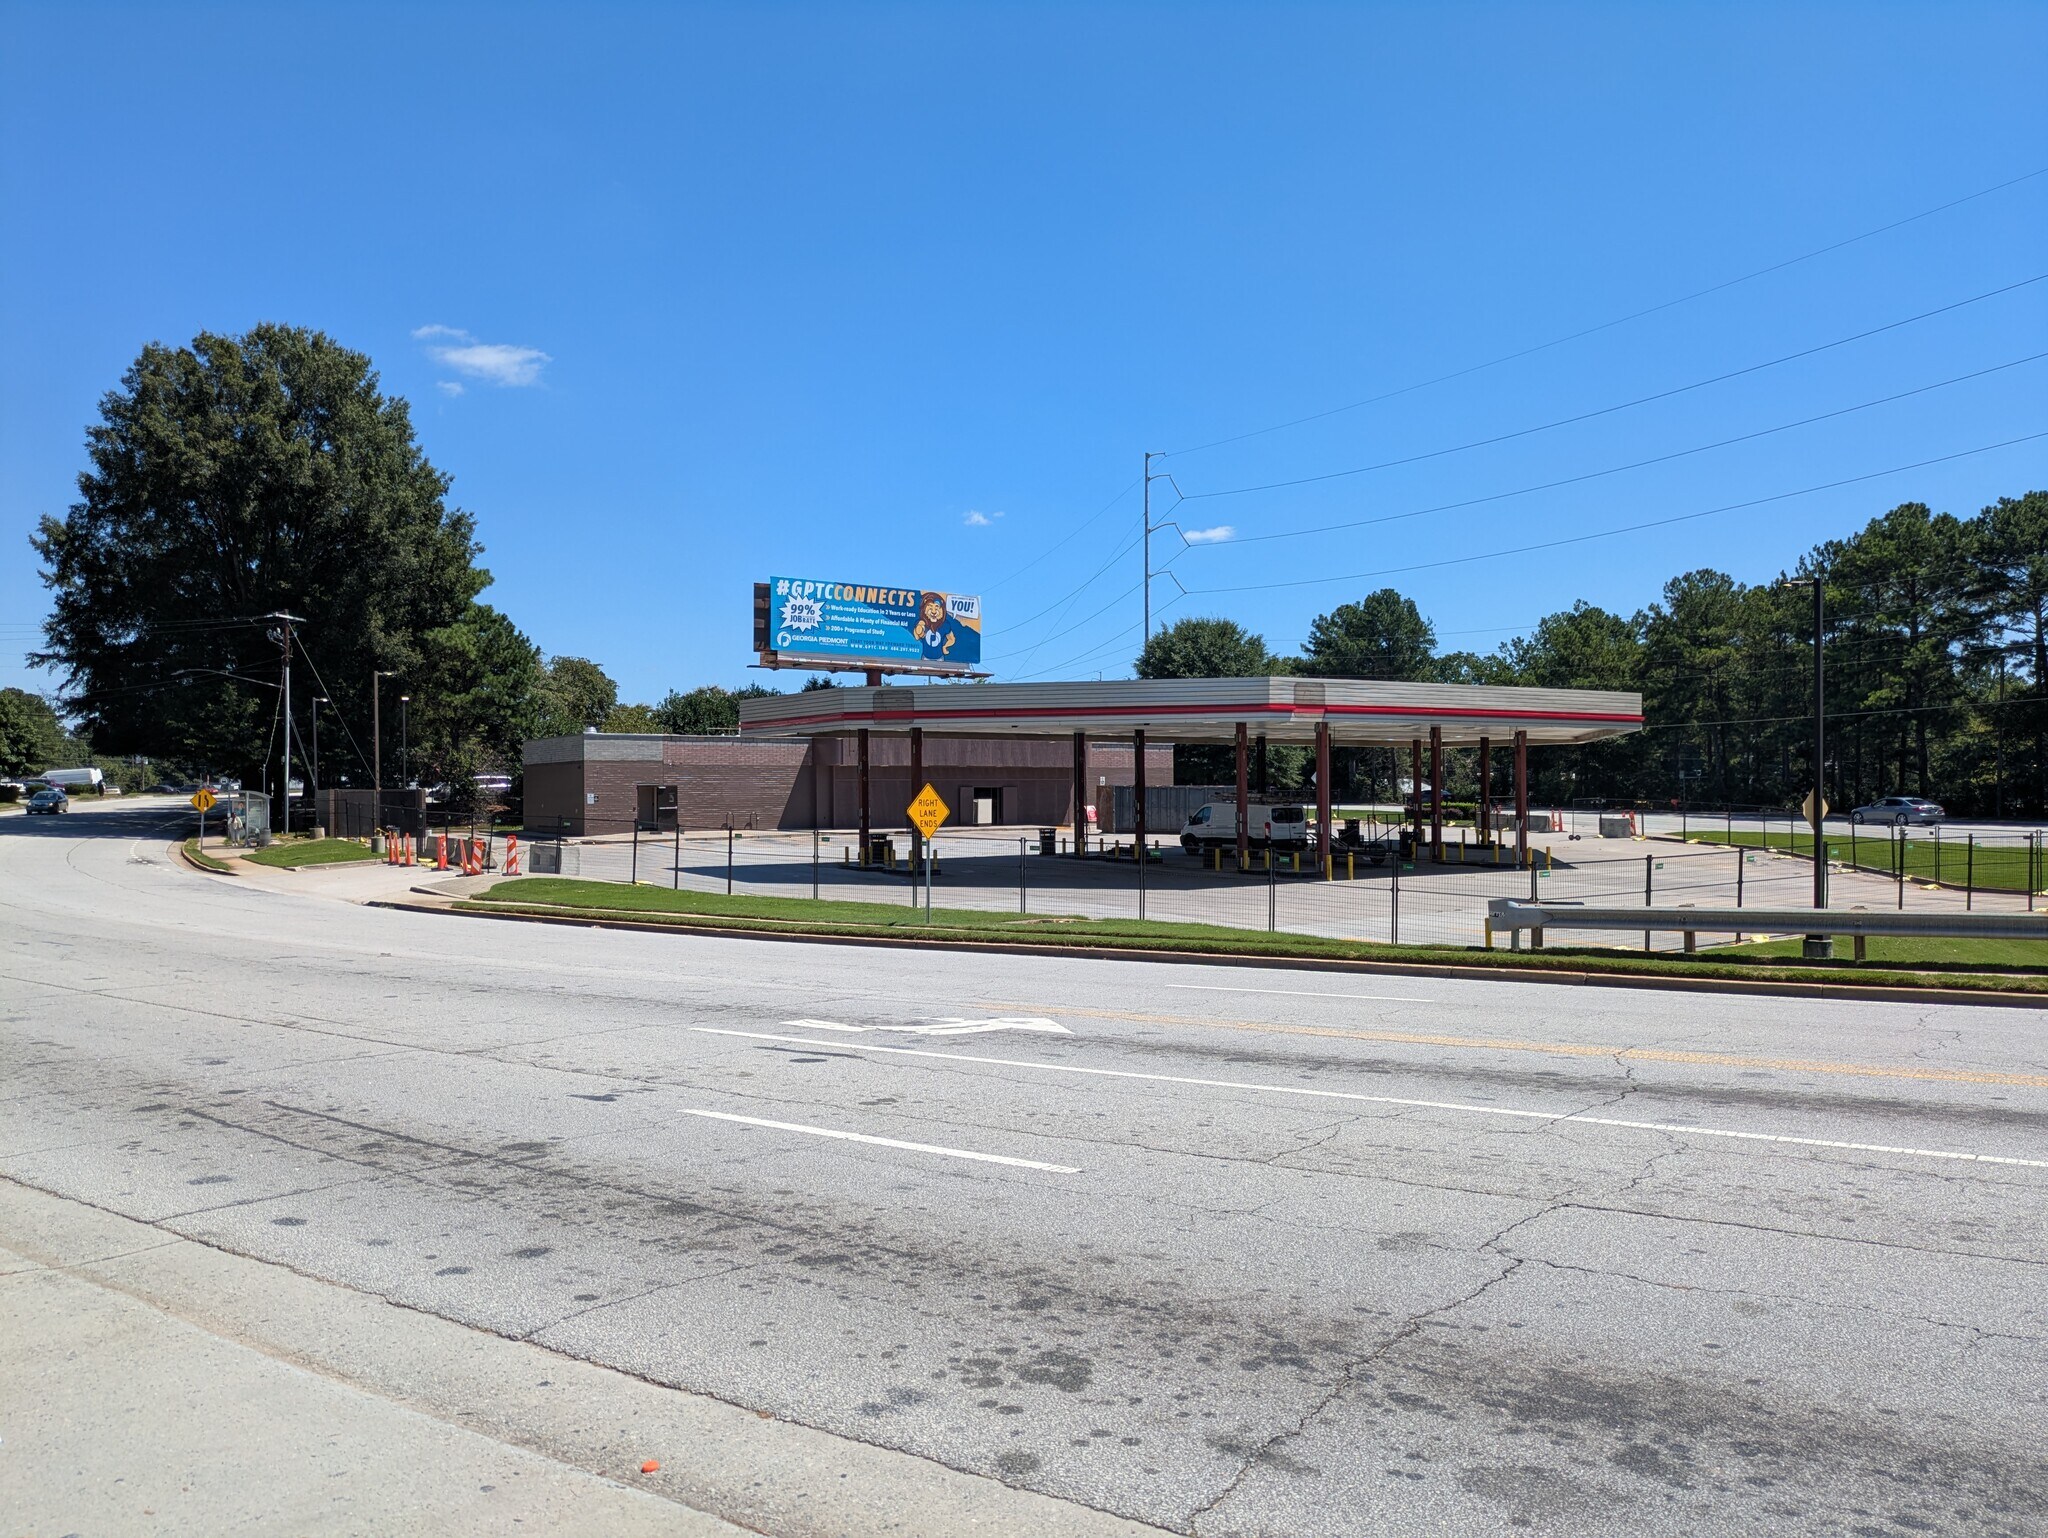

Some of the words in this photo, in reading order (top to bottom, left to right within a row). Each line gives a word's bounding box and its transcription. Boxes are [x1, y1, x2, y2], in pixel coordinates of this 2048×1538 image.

[790, 604, 815, 615] 99%
[831, 604, 857, 613] Work-ready
[858, 606, 879, 614] Education
[951, 600, 974, 613] YOU!
[790, 615, 802, 623] JOB
[831, 615, 854, 623] Affordable
